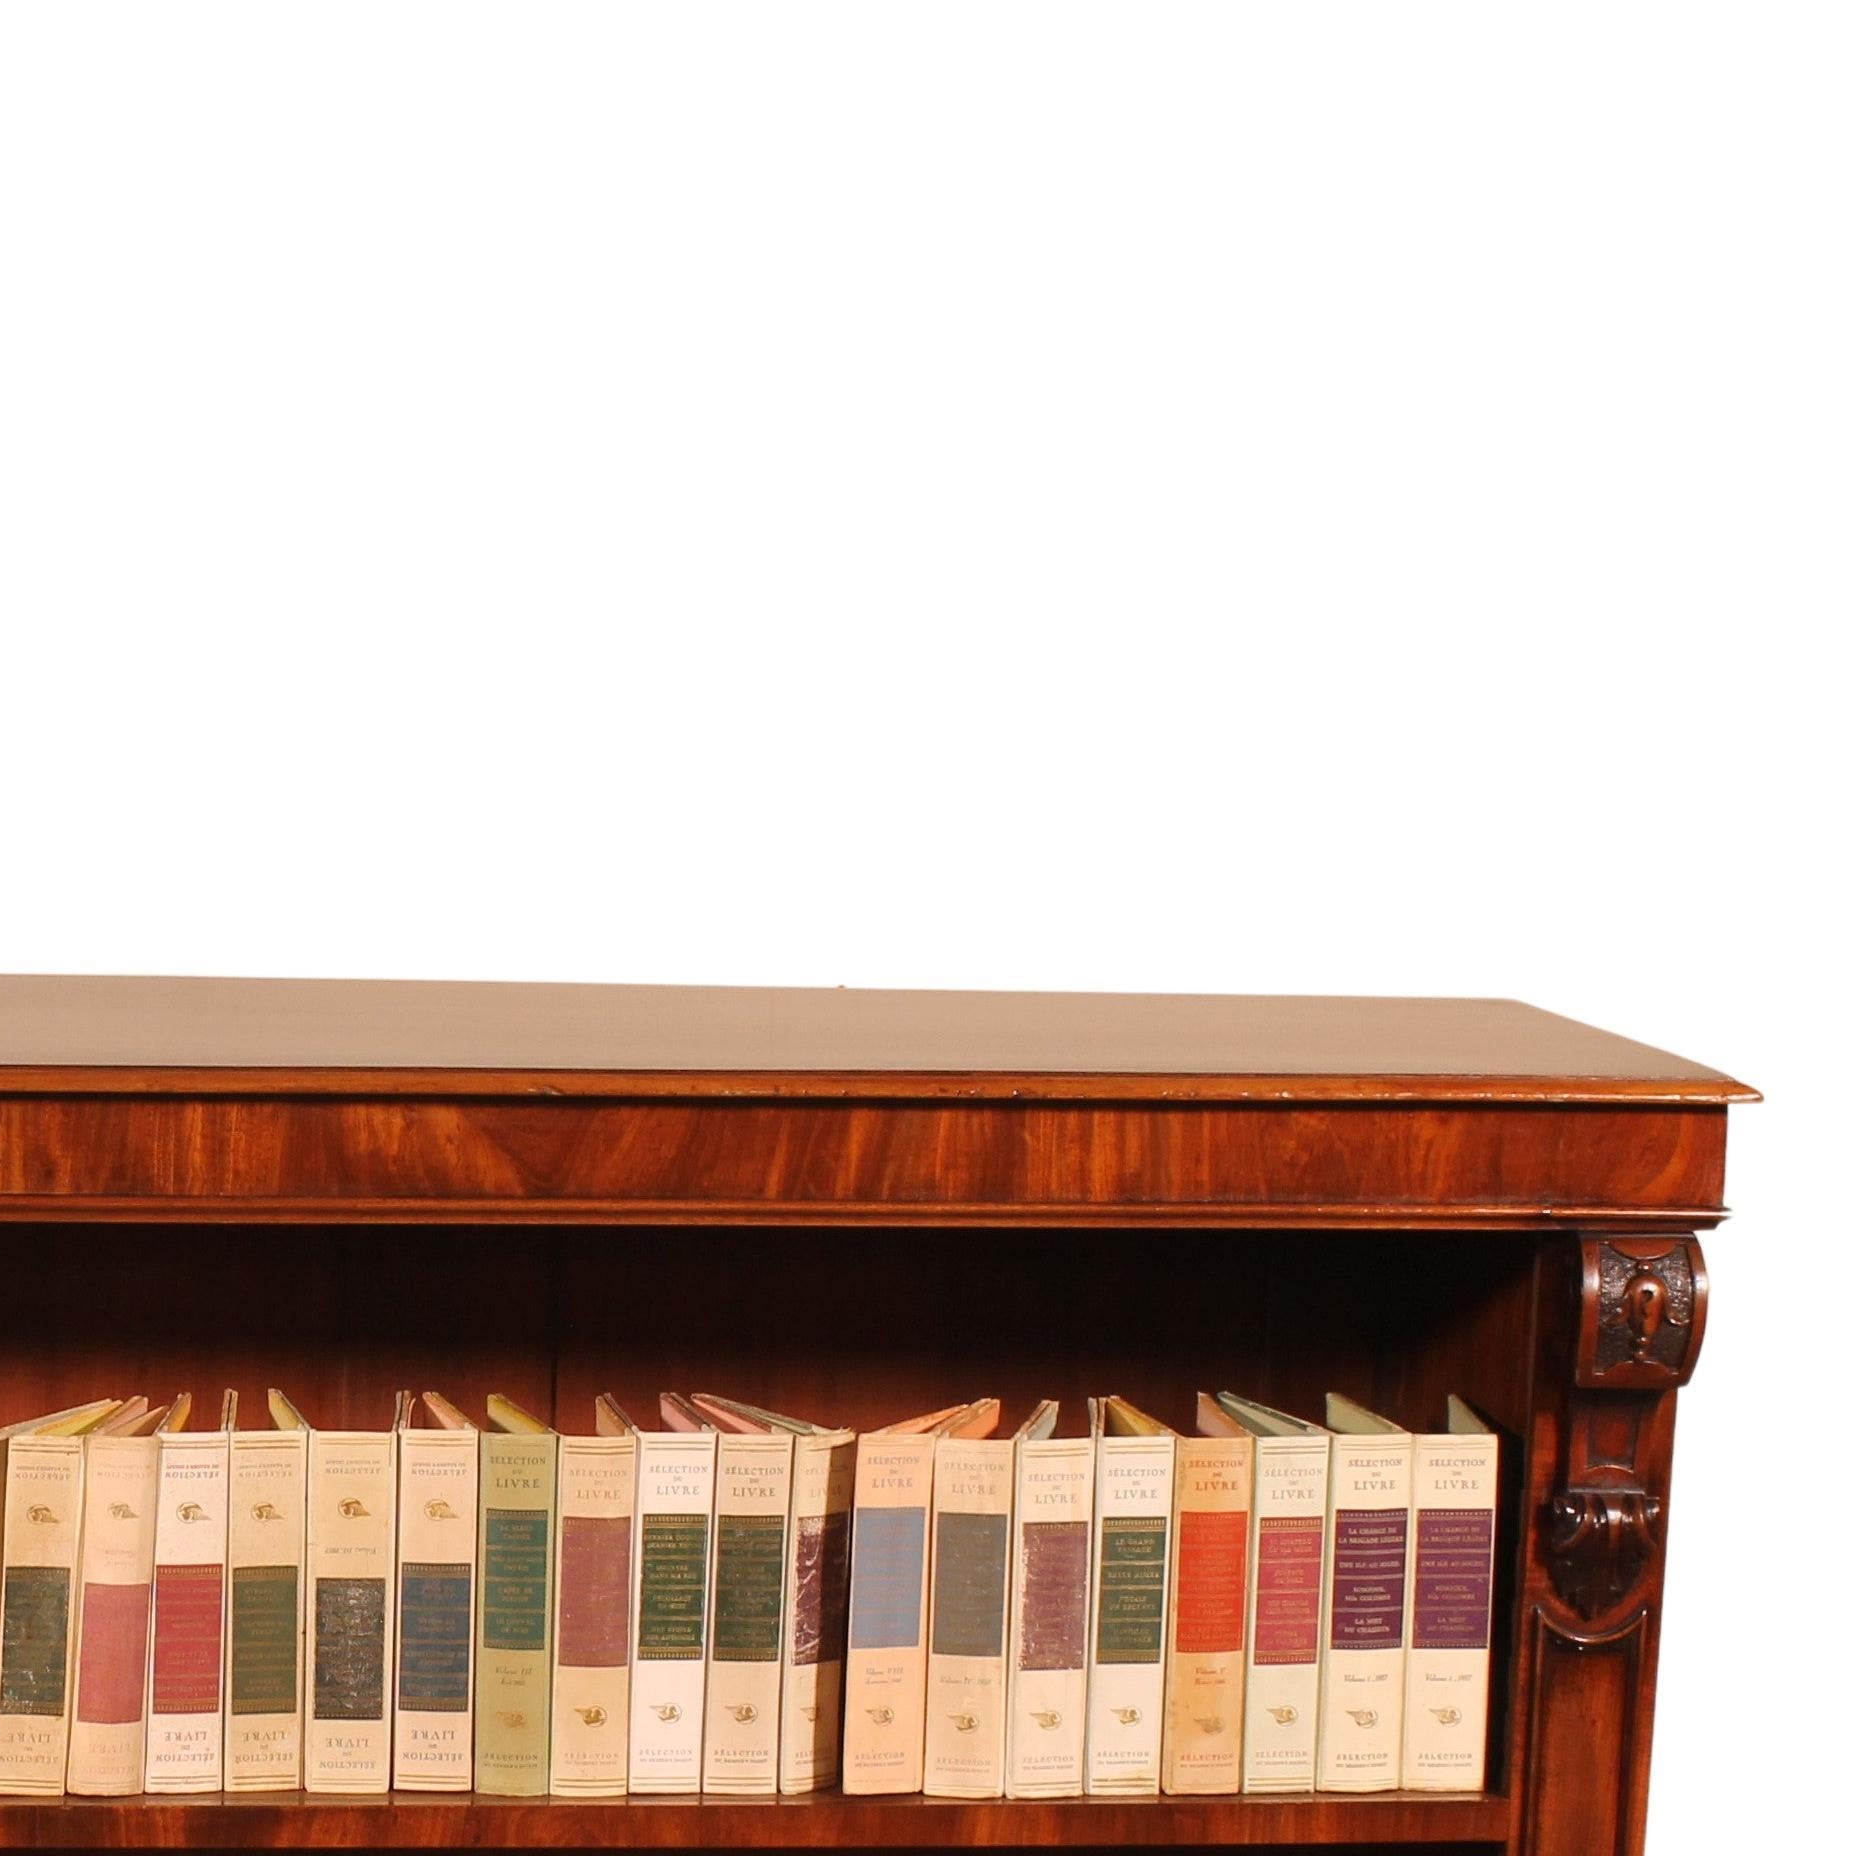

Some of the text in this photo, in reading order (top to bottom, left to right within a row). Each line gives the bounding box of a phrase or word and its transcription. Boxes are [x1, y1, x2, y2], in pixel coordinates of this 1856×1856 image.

[490, 1455, 546, 1465] SÉLECTION
[867, 1456, 920, 1465] SÉLECTION
[1188, 1459, 1244, 1469] SÉLECTION
[1348, 1458, 1402, 1467] SÉLECTION
[1428, 1458, 1486, 1467] SÉLECTION
[569, 1469, 627, 1478] SÉLECTION
[649, 1464, 708, 1474] SÉLECTION
[725, 1466, 784, 1476] SÉLECTION
[1107, 1468, 1166, 1477] SÉLECTION
[1264, 1468, 1322, 1478] SÉLECTION
[1027, 1472, 1086, 1482] SÉLECTION
[496, 1478, 541, 1489] LIVRE
[871, 1478, 913, 1489] LIVRE
[1195, 1480, 1239, 1491] LIVRE
[1354, 1480, 1396, 1490] LIVRE
[1434, 1480, 1479, 1490] LIVRE
[577, 1489, 621, 1500] LIVRE
[656, 1485, 700, 1496] LIVRE
[731, 1487, 776, 1498] LIVRE
[952, 1484, 996, 1496] LIVRE
[1115, 1489, 1158, 1499] LIVRE
[1271, 1489, 1315, 1499] LIVRE
[1035, 1494, 1080, 1505] LIVRE
[7, 1732, 51, 1744] LIVRE
[164, 1731, 207, 1743] LIVRE
[241, 1731, 286, 1743] LIVRE
[410, 1728, 455, 1740] LIVRE
[325, 1737, 368, 1748] LIVRE
[156, 1753, 214, 1763] SÉLECTION
[401, 1751, 463, 1762] SÉLECTION
[319, 1761, 377, 1770] SÉLECTION
